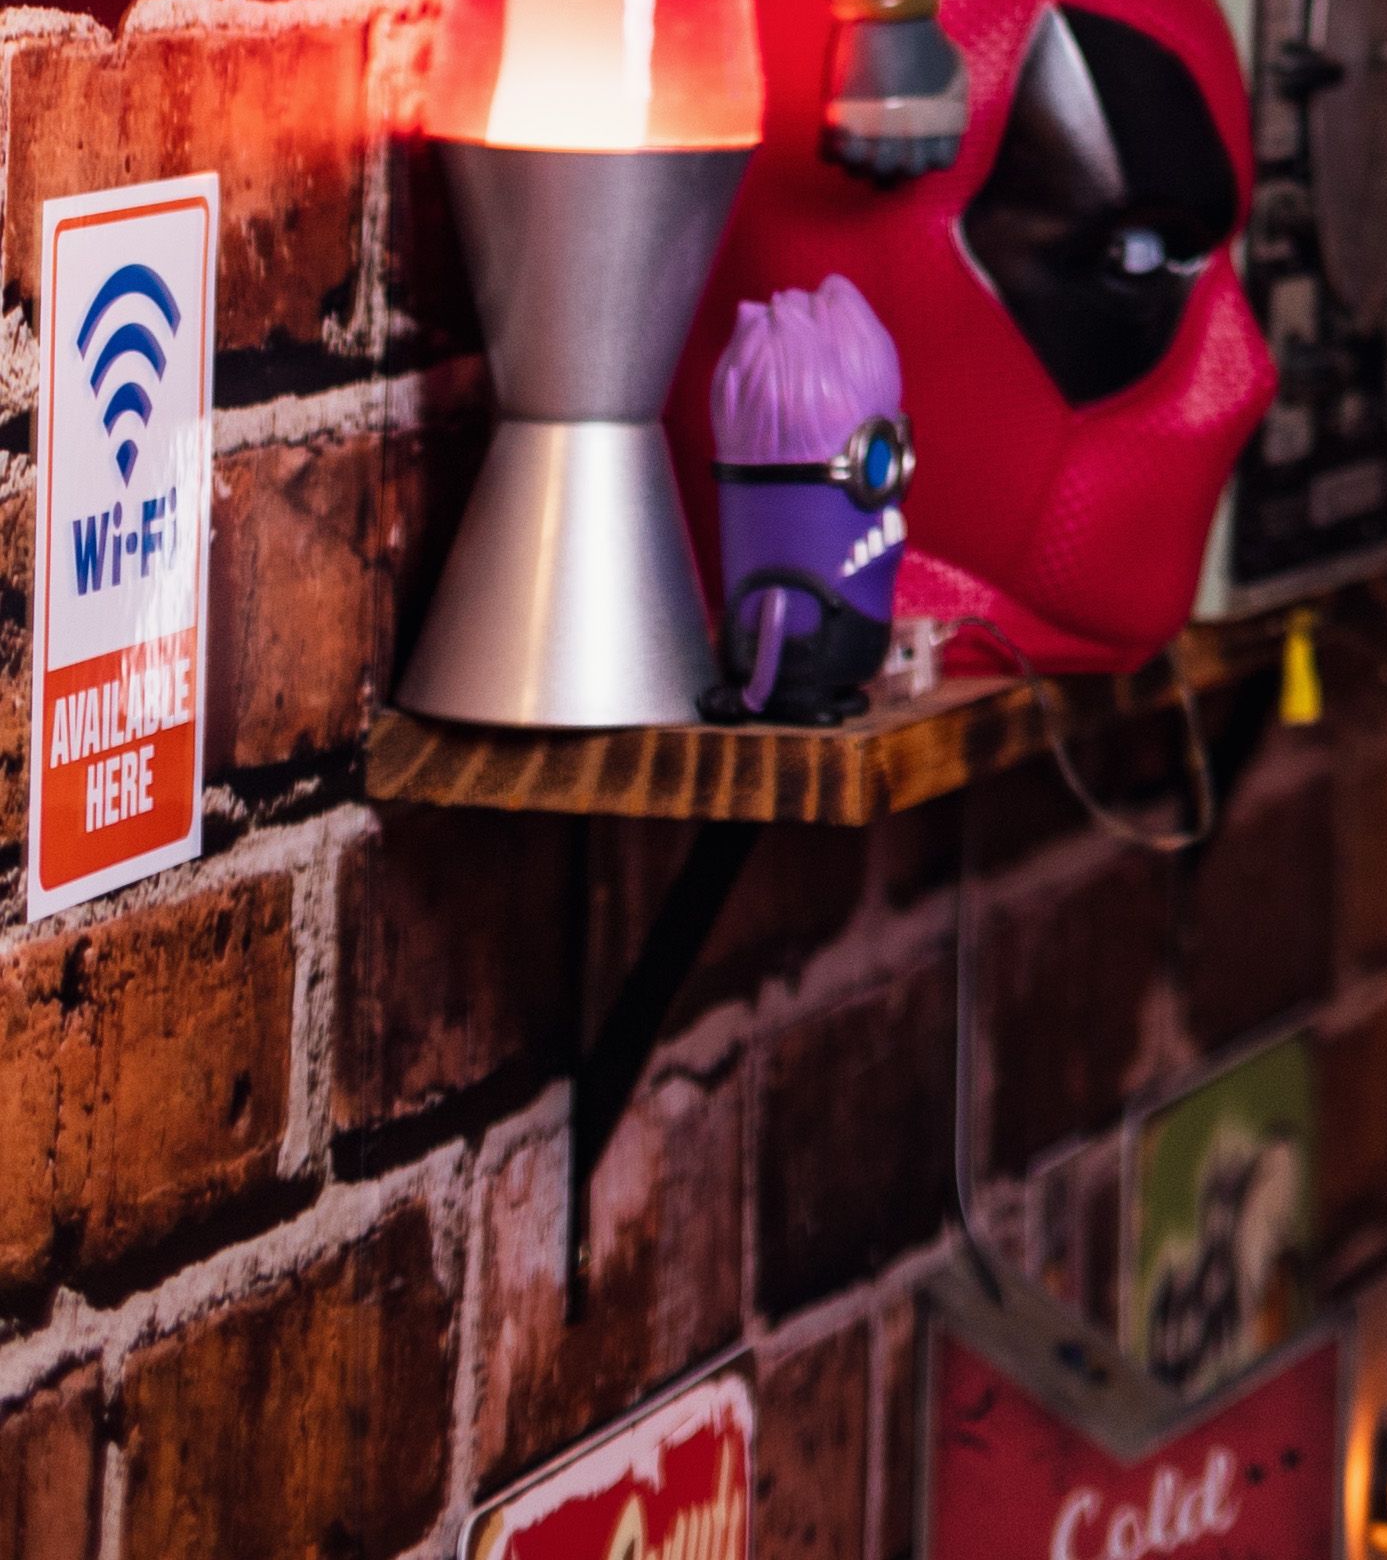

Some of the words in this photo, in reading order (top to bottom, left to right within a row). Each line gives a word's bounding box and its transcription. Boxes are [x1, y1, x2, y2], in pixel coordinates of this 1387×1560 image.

[49, 658, 190, 770] AVAILABLE
[86, 744, 154, 834] HERE
[1050, 1447, 1241, 1560] Cold
